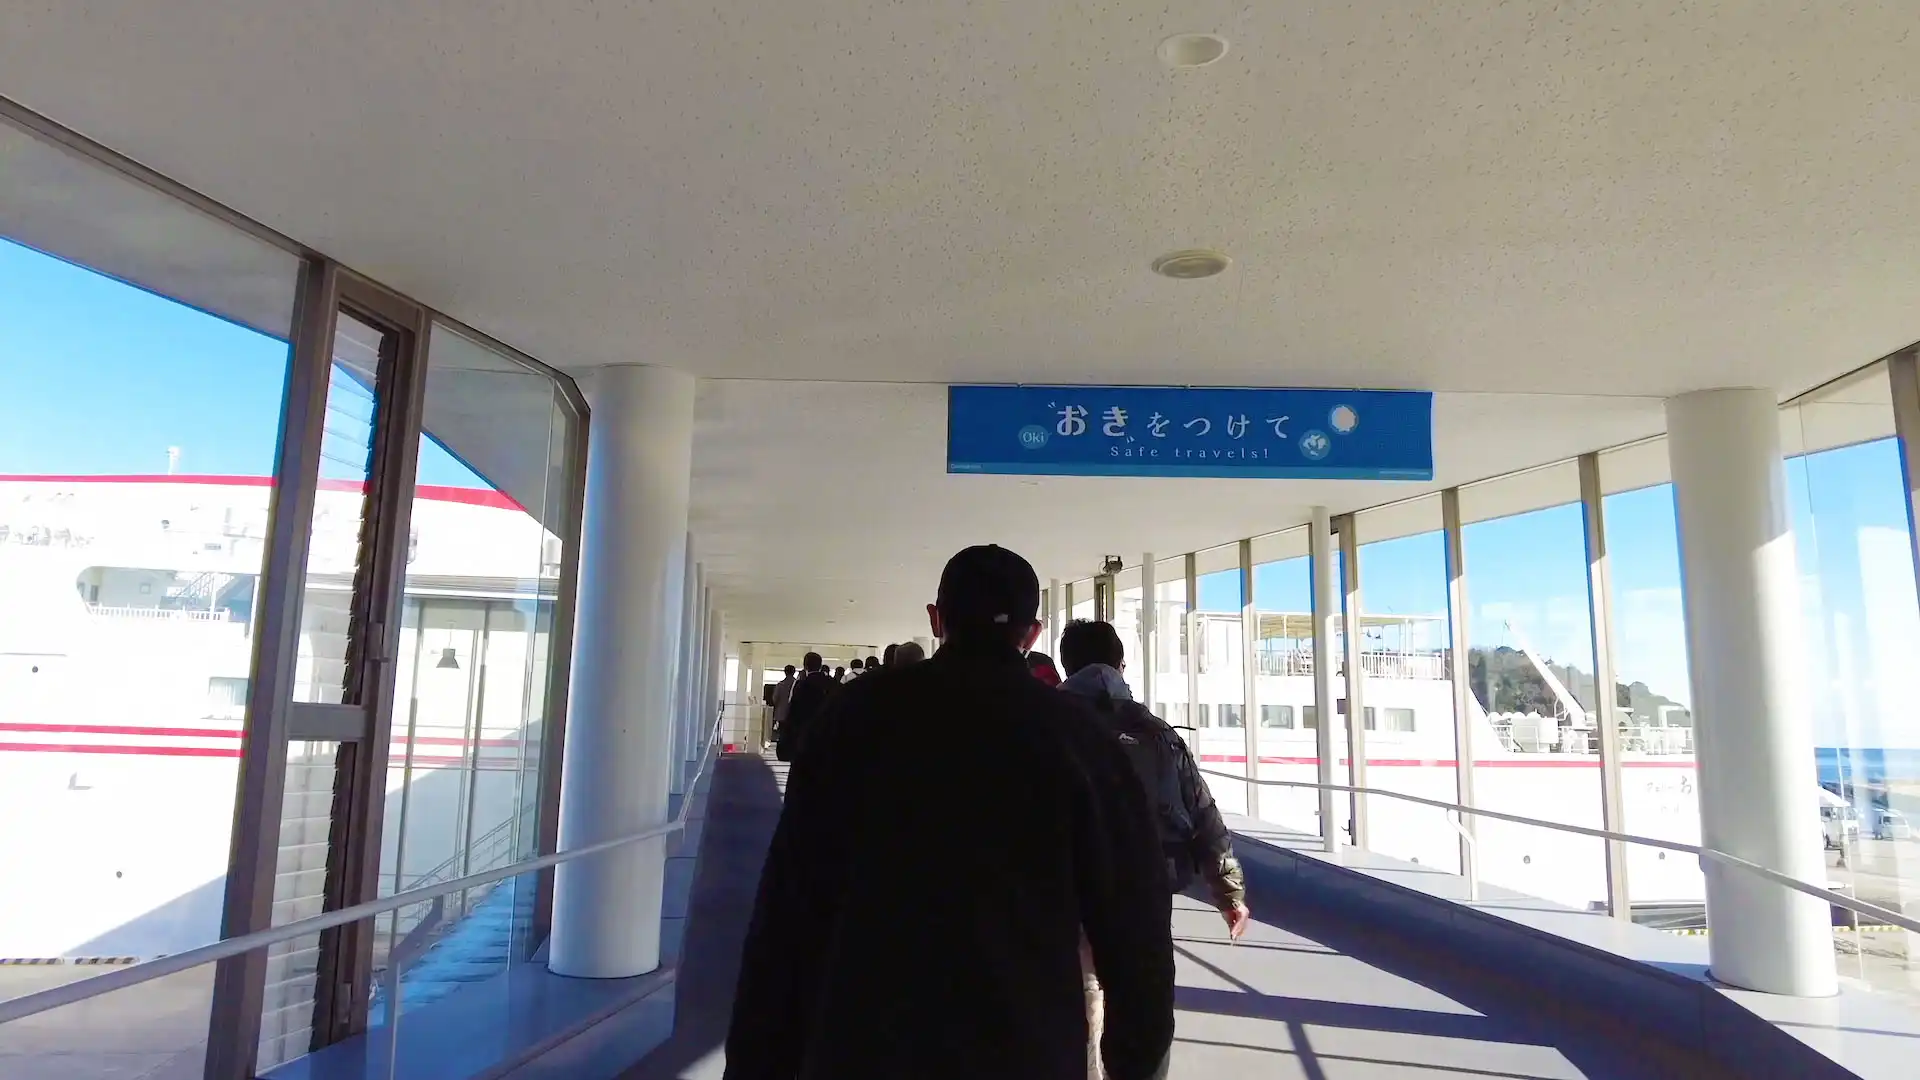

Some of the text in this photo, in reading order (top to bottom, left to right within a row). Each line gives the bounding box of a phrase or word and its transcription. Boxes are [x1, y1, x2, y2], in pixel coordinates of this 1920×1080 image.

[1022, 431, 1045, 443] Oki
[1110, 446, 1269, 459] Safe travels!
